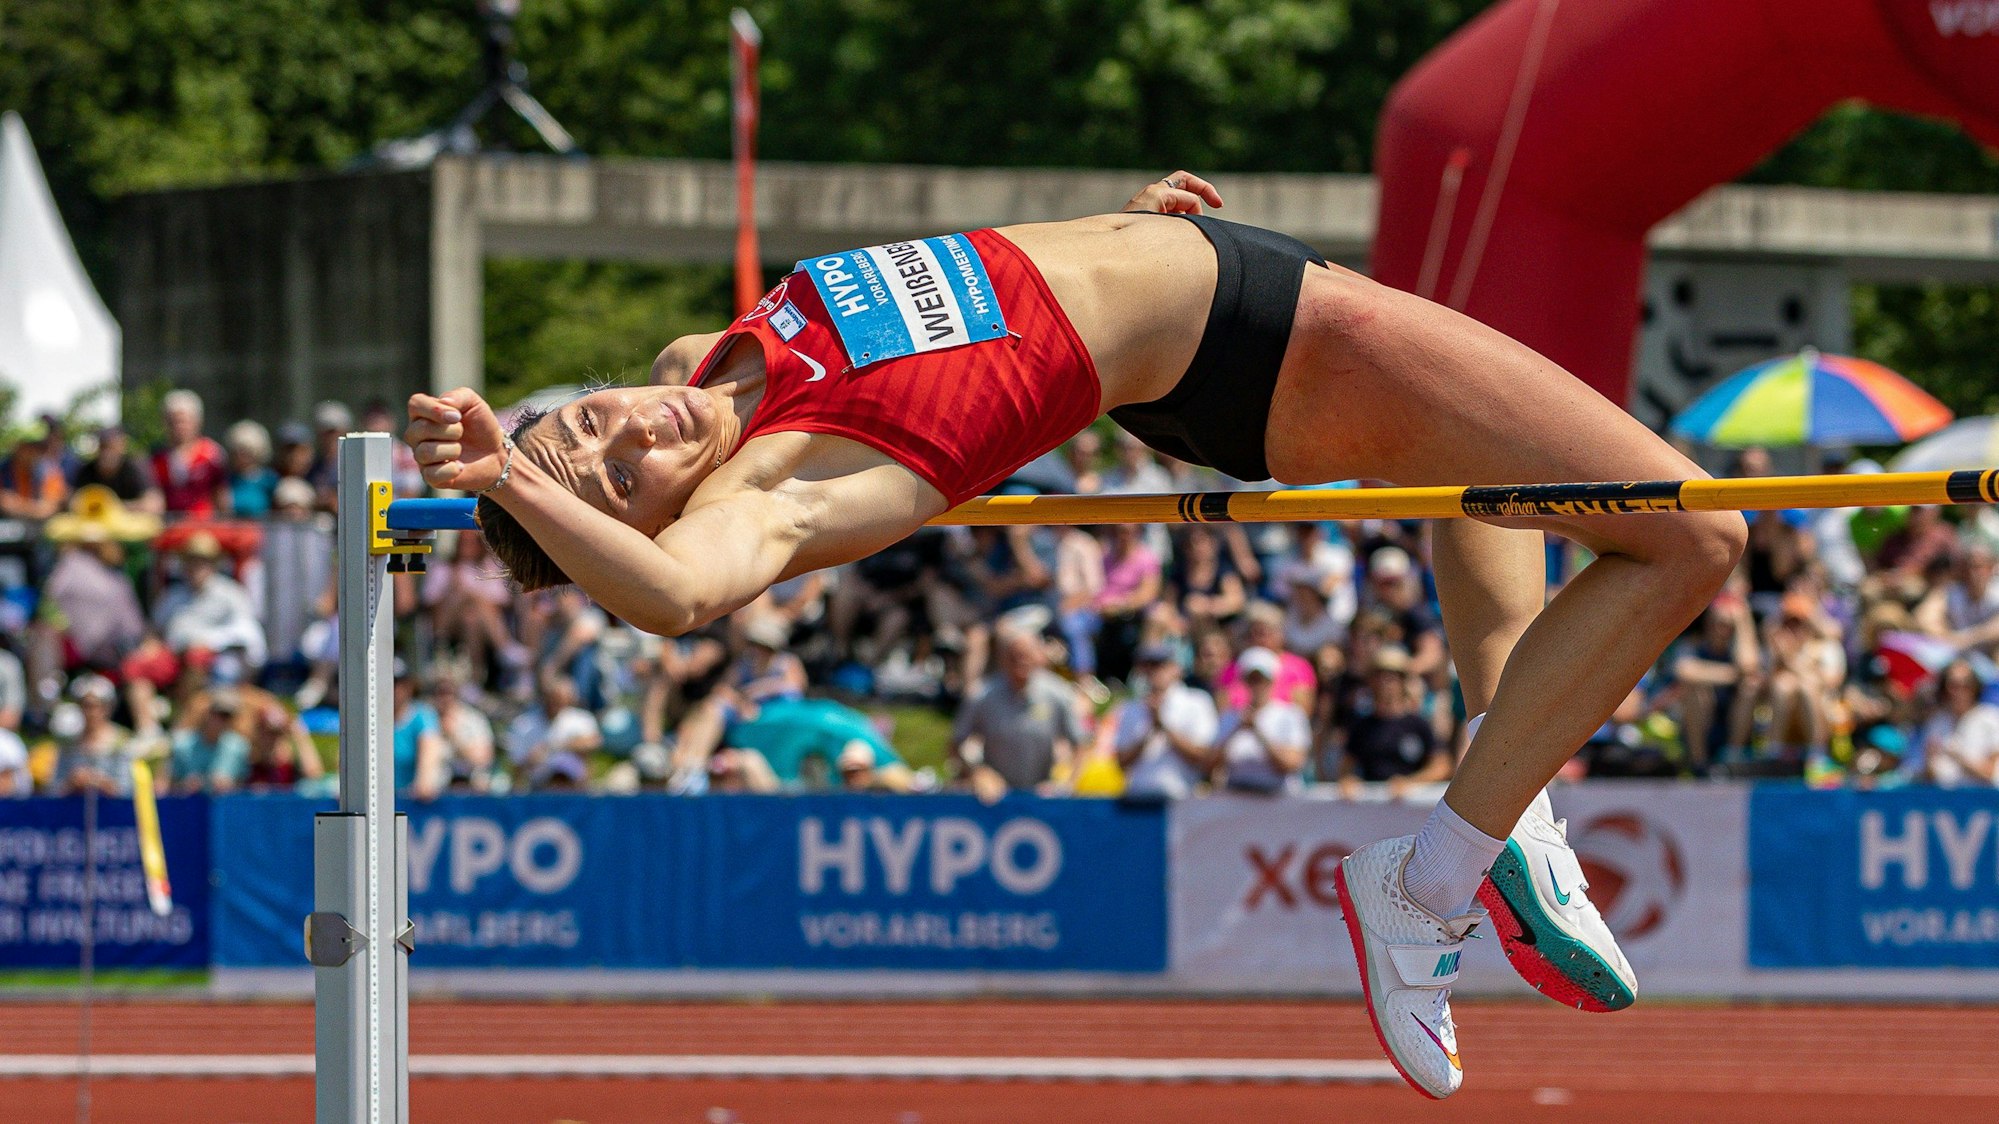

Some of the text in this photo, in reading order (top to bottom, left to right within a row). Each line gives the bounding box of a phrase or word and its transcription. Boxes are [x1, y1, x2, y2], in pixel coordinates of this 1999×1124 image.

[816, 257, 870, 318] HYPO
[850, 251, 889, 306] VORARLBERG
[799, 816, 1063, 896] HYPO
[1860, 810, 1999, 891] HY
